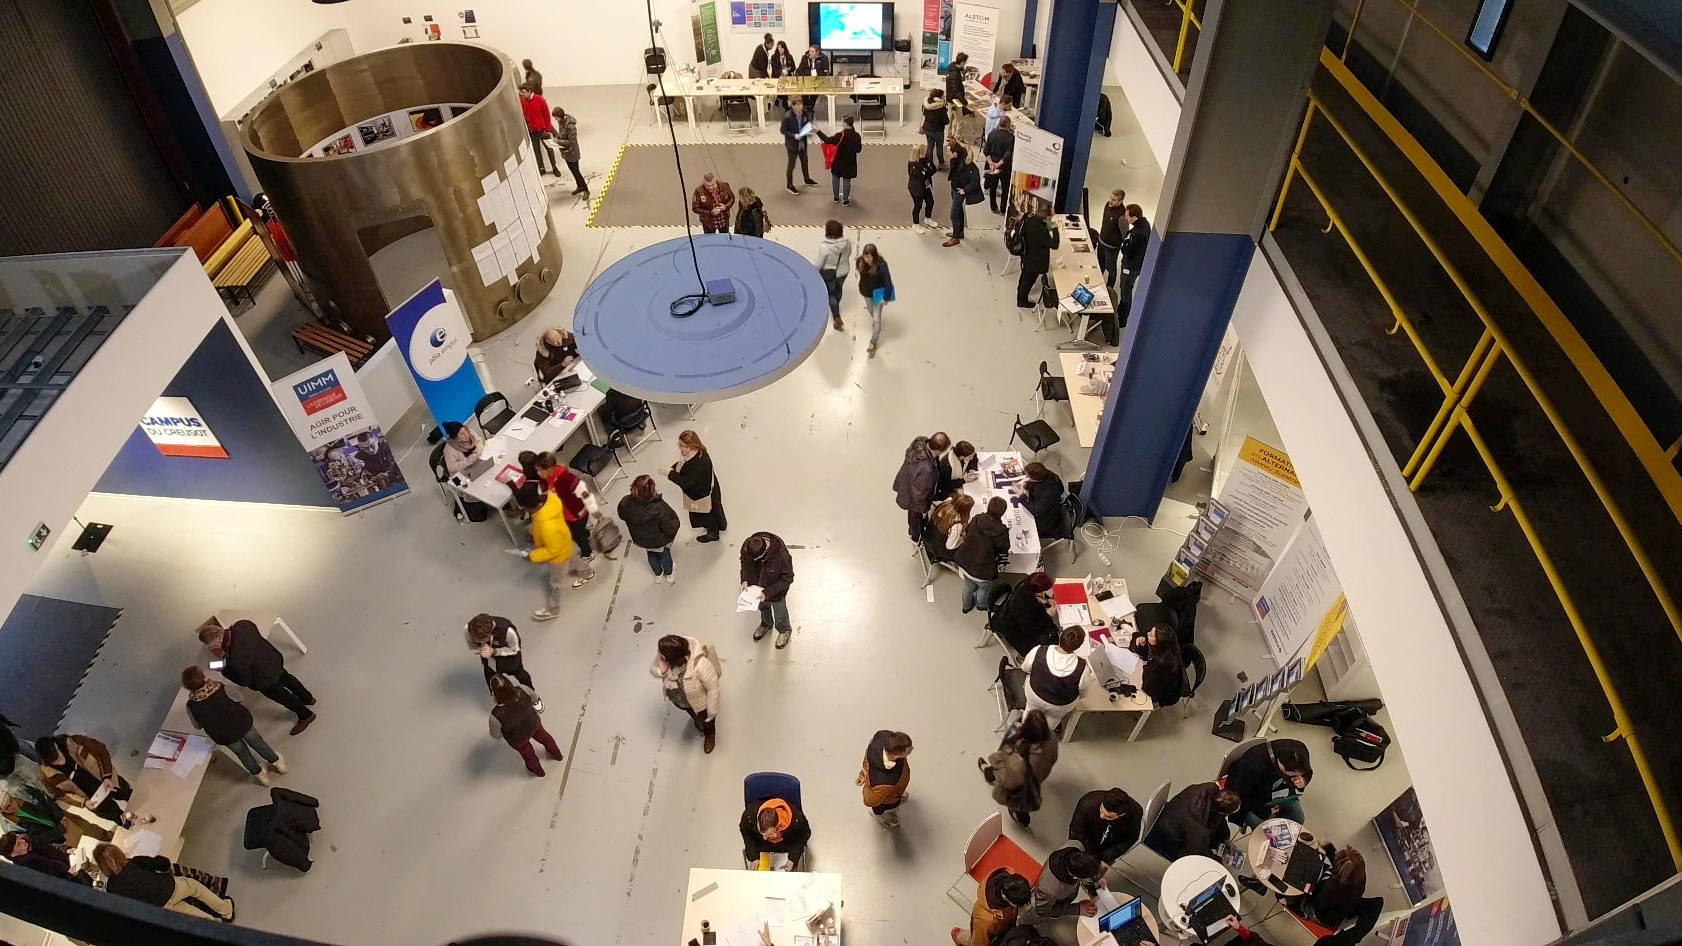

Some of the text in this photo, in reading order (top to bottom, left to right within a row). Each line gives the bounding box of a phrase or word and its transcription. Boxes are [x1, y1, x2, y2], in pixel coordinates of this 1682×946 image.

[441, 337, 458, 354] emploi
[297, 373, 335, 395] UIMM
[310, 406, 358, 431] AGIR POUR
[310, 413, 364, 440] L'INDUSTRIE
[147, 428, 208, 437] DU CREUSOT
